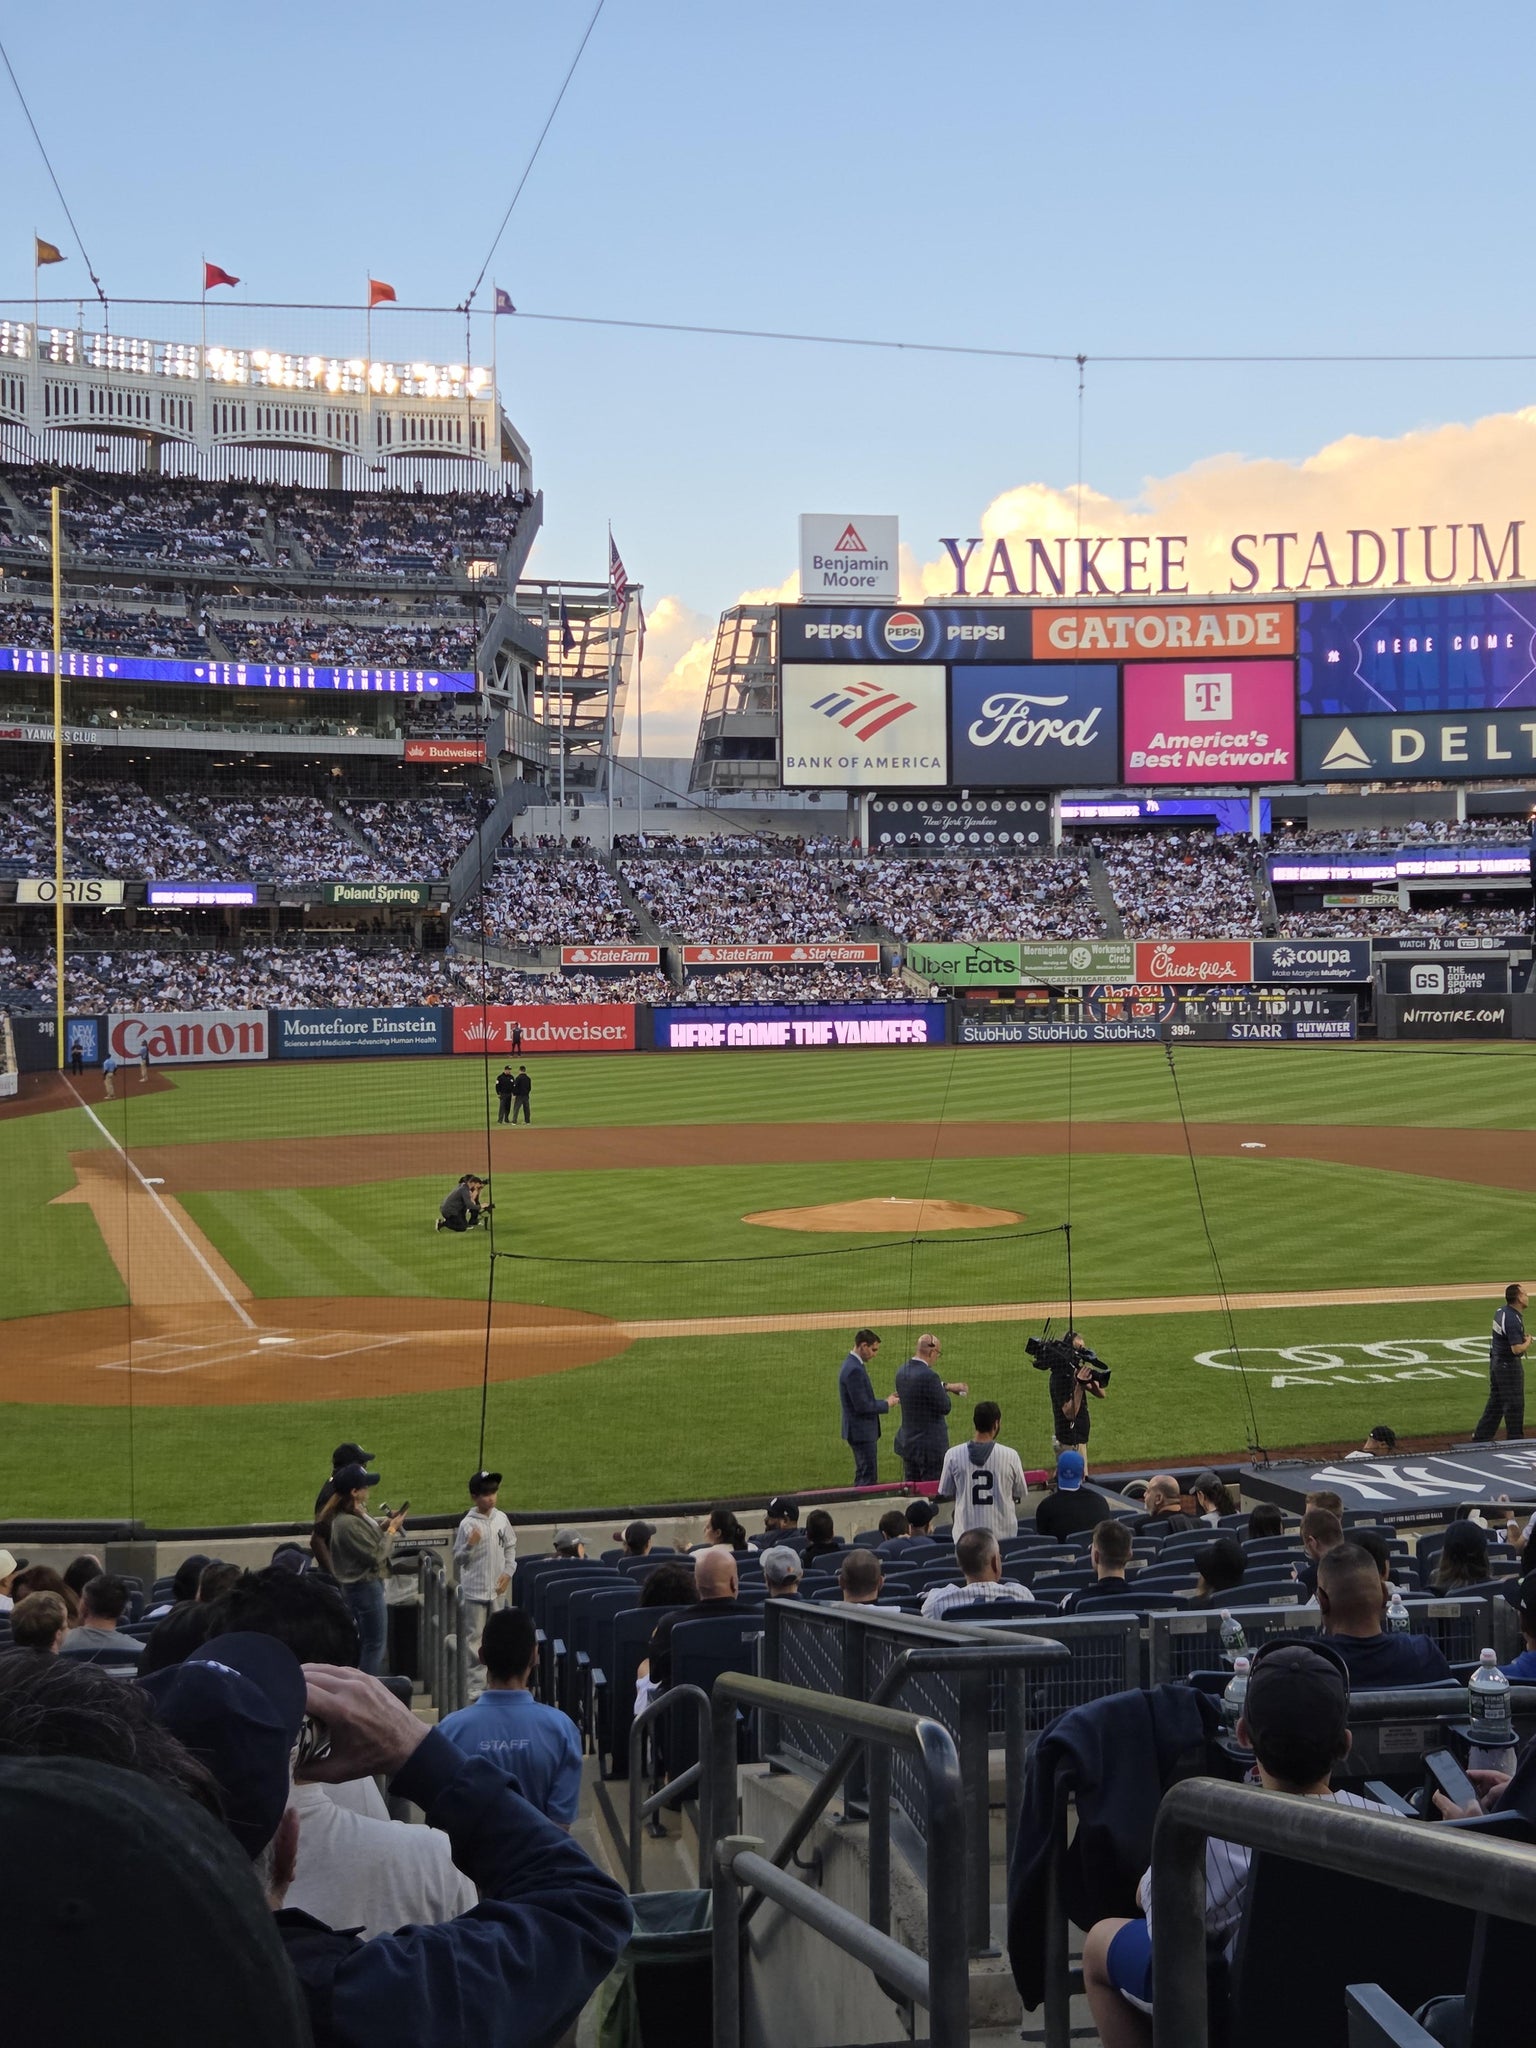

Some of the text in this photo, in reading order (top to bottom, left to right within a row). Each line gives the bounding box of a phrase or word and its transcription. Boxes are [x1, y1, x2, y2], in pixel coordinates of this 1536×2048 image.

[812, 555, 889, 575] Benjamin
[938, 520, 1526, 596] YANKEE STADIUM
[823, 571, 876, 588] Moore
[805, 623, 863, 640] PEPSI
[887, 627, 922, 637] PEPSI
[947, 625, 1006, 641] PEPSI
[1048, 612, 1281, 649] GATORADE
[1377, 633, 1514, 654] HERE COME
[12, 658, 104, 678] YANEES
[209, 671, 247, 686] NEW
[264, 673, 316, 689] YORK
[333, 676, 424, 692] YANKEES
[967, 692, 1103, 747] Ford
[26, 728, 71, 742] YANKES
[73, 731, 97, 743] CLUB
[1148, 730, 1269, 750] America's
[429, 747, 483, 759] Budweiser
[1130, 748, 1290, 769] Best Network
[787, 756, 941, 768] BANK OF AMERICA
[922, 815, 997, 830] New York Yankees
[37, 882, 103, 902] ORIS
[334, 885, 418, 903] Poland Spring
[1023, 945, 1068, 957] Morningside
[1399, 940, 1426, 948] WATCH
[1443, 940, 1455, 948] ON
[912, 955, 1015, 974] Uber Eats
[1108, 954, 1131, 964] Circle
[1150, 951, 1237, 978] Chick-fil-A
[1296, 949, 1350, 967] coupa
[1292, 970, 1320, 978] Margins
[1415, 973, 1440, 988] GS
[1447, 973, 1485, 981] GOTHAM
[1447, 980, 1483, 988] SPORTS
[1403, 1008, 1505, 1023] NITTOTIRE.COM
[38, 1021, 55, 1033] 318
[72, 1024, 94, 1036] NEW
[284, 1017, 437, 1035] Montefiore Einstein
[964, 1024, 1156, 1042] StubHub StubHub StubHub
[1231, 1024, 1283, 1038] STARR
[1296, 1022, 1350, 1032] CUTWATER
[111, 1018, 264, 1059] Canon
[284, 1040, 308, 1048] Science
[414, 1036, 437, 1044] Health
[1271, 1366, 1487, 1388] Audi
[972, 1469, 994, 1506] 2
[480, 1739, 531, 1750] STAFF
